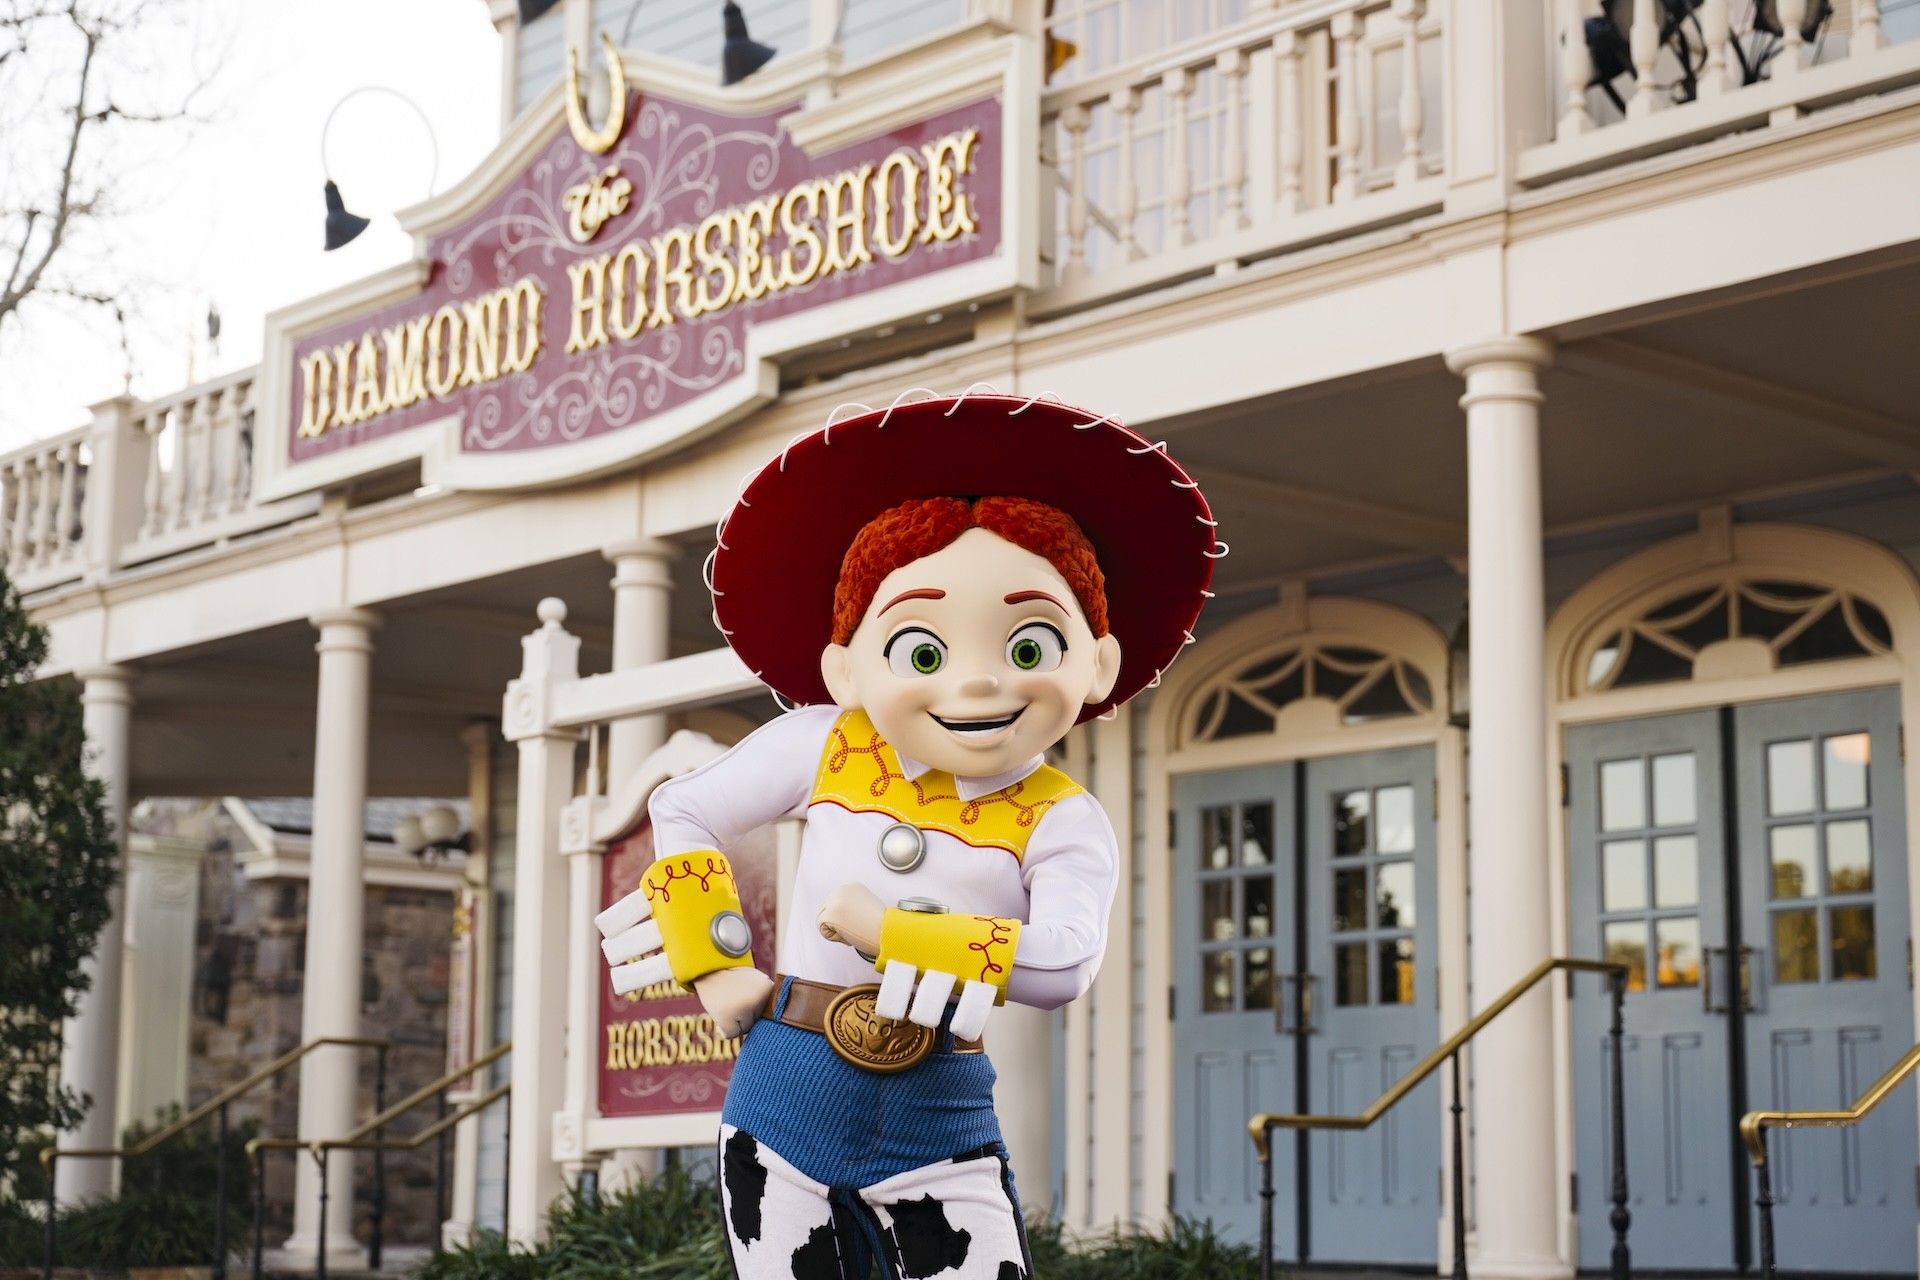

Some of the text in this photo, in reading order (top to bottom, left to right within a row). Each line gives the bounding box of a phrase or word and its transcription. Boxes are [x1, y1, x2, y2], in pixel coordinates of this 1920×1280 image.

[562, 164, 632, 243] The
[297, 128, 979, 438] DIAMOND HORSESHOE
[605, 1012, 741, 1071] HORSESH
